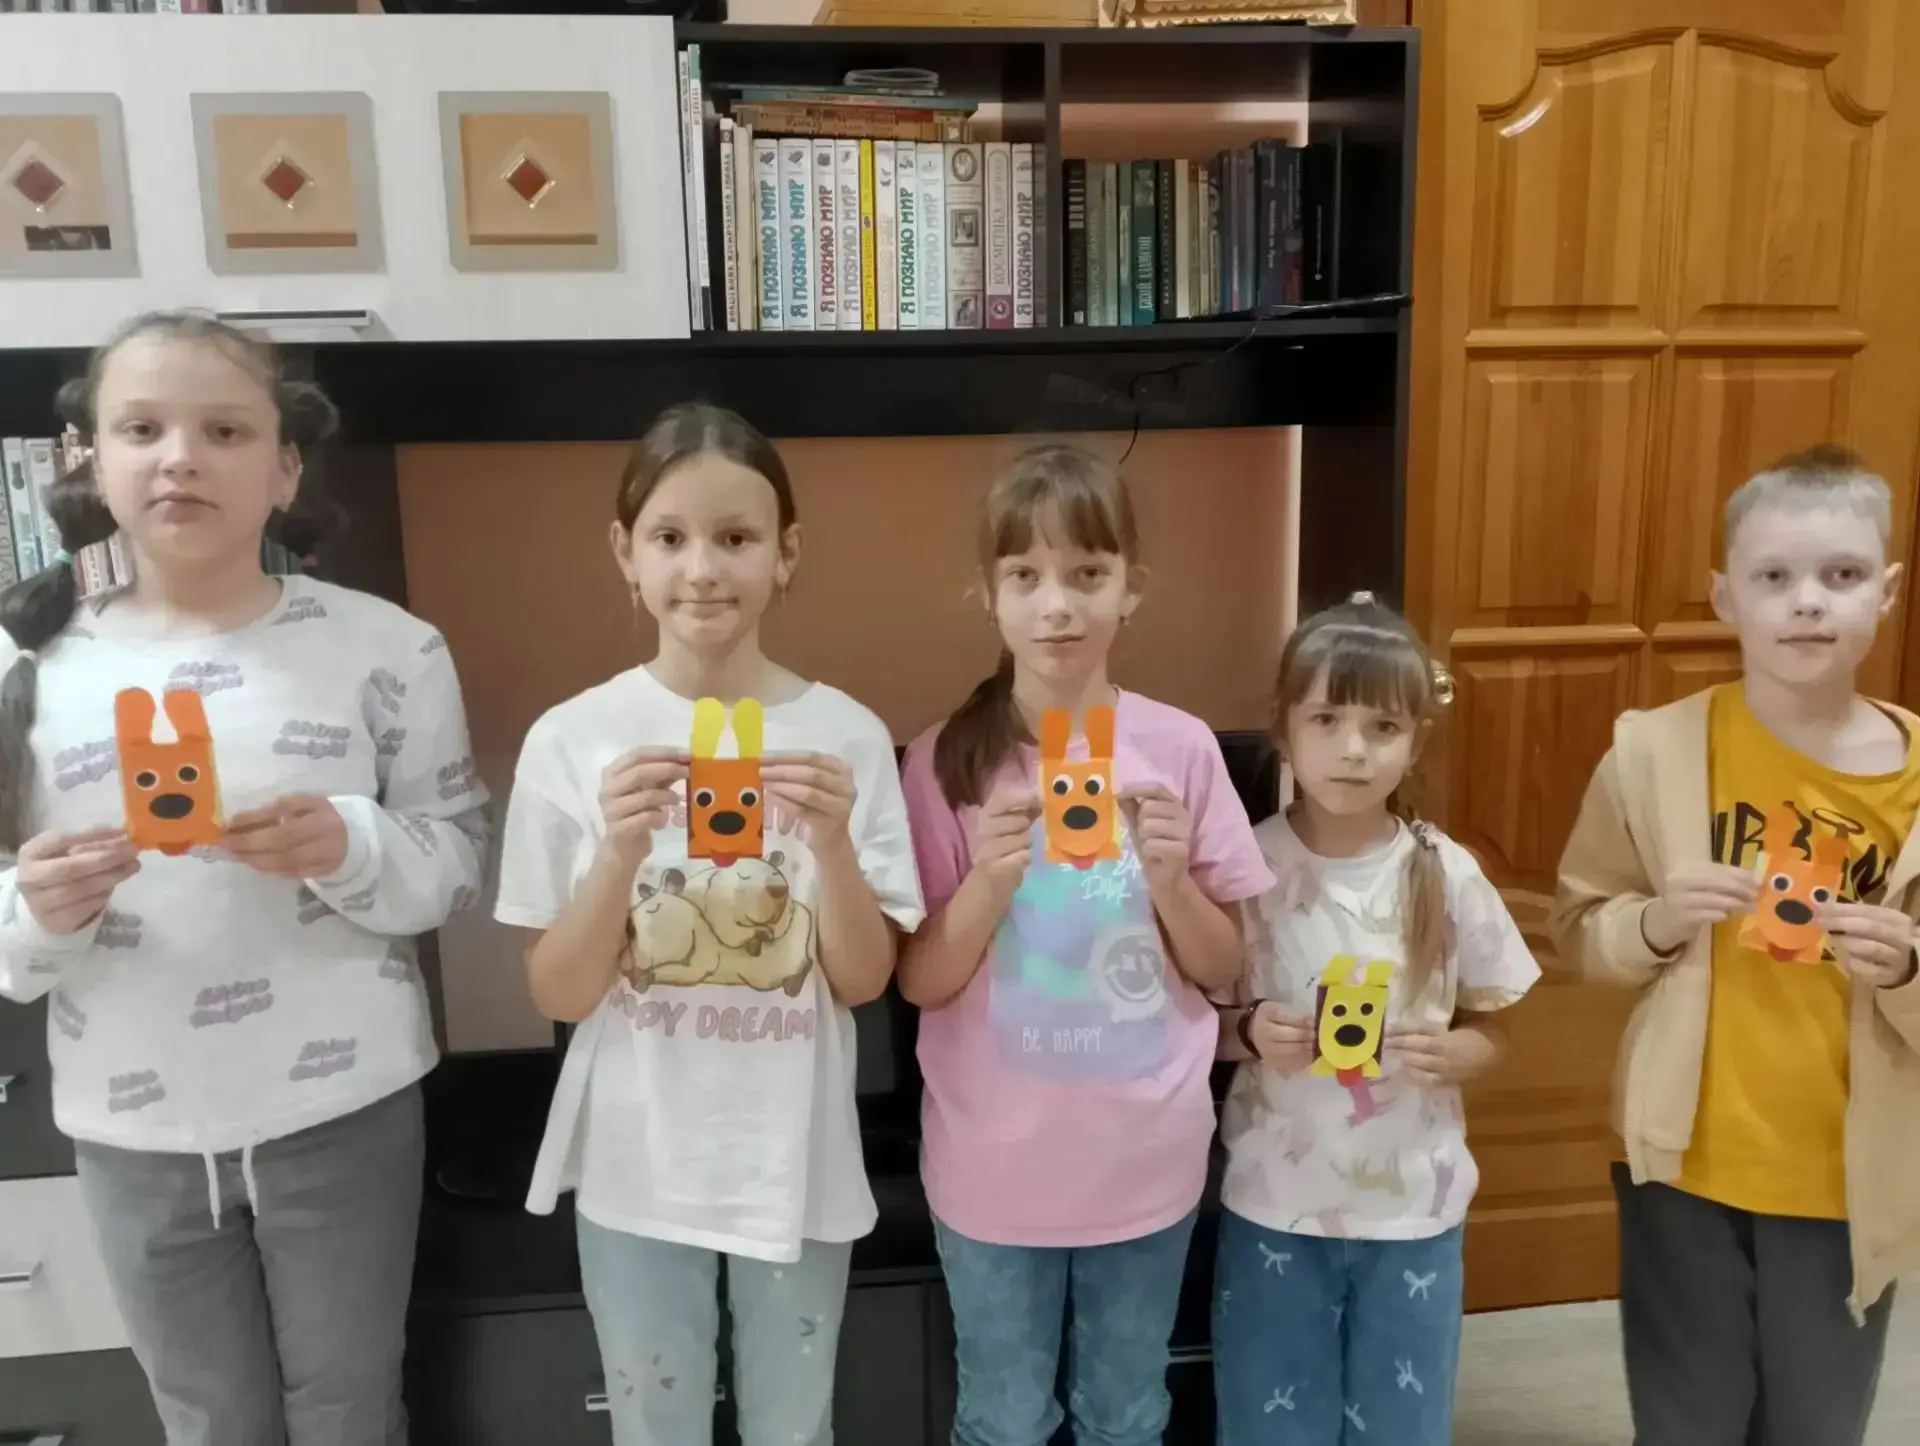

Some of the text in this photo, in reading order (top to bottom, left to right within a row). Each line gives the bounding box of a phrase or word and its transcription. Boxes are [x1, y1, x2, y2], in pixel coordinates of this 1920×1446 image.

[759, 180, 779, 320] Я ПОЗНАЮ МИР
[788, 179, 808, 318] Я ПОЗНАЮ МИР
[818, 184, 835, 313] Я ПОЗНАЮ МИР
[842, 184, 859, 312] Я ПОЗНАЮ МИР
[899, 187, 915, 314] Я ПОЗНАЮ МИР
[1016, 192, 1032, 316] Я ПОЗНАЮ МИР
